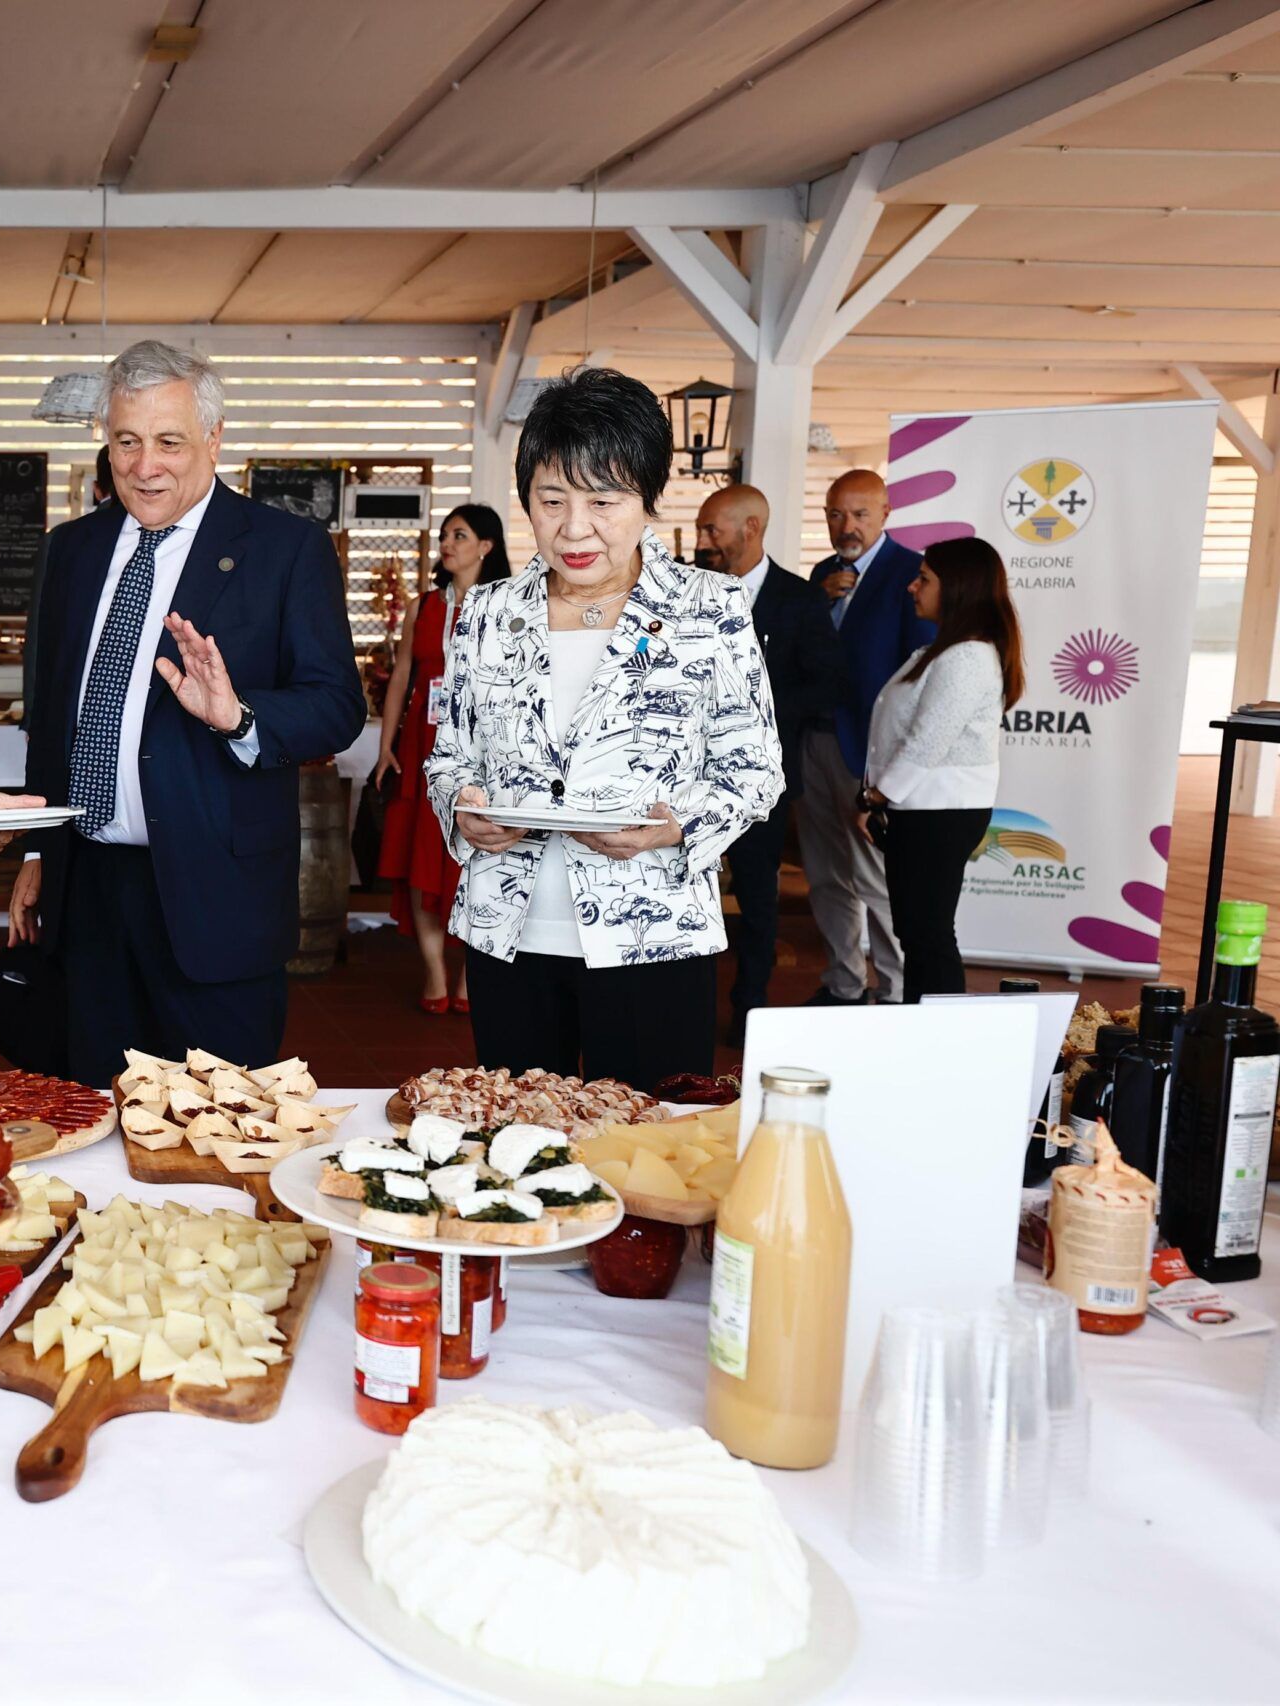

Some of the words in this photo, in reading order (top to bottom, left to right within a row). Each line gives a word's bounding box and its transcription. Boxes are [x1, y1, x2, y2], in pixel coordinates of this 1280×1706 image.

[1010, 556, 1074, 568] REGIONE
[1013, 863, 1086, 881] ARSAC
[970, 877, 1014, 886] Regionale
[1045, 881, 1085, 890] Sviluppo
[969, 886, 1019, 896] Agricoltura
[1021, 890, 1066, 898] Calabrese
